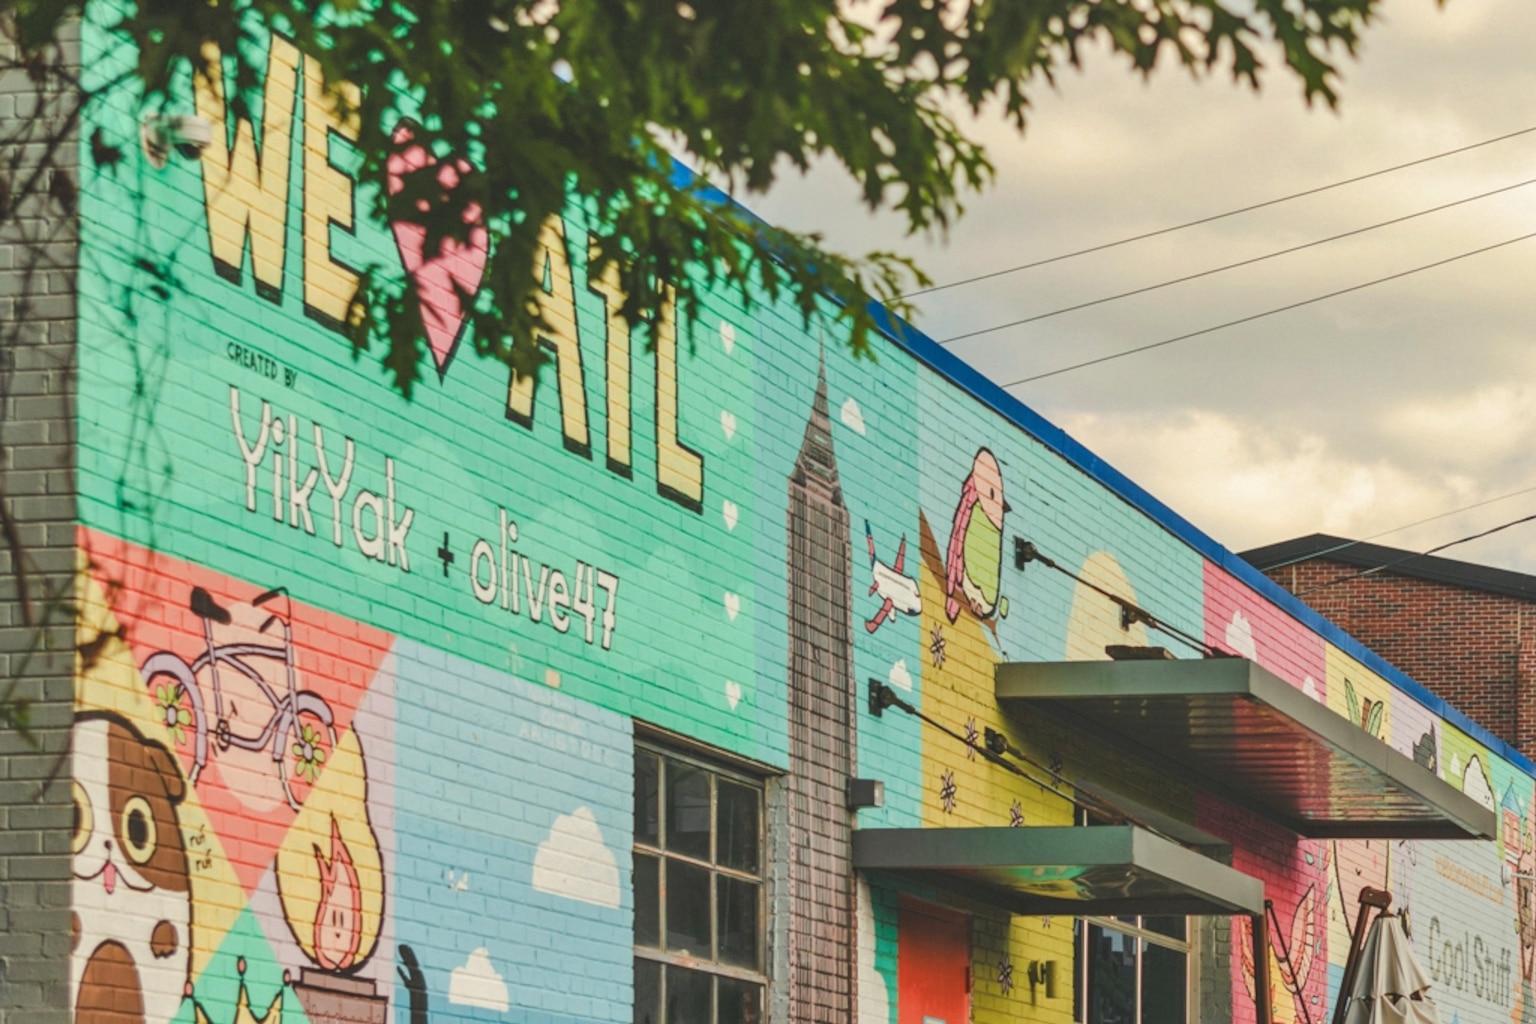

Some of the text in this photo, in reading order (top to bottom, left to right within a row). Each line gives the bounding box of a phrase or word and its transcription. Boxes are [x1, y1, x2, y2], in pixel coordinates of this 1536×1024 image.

[194, 32, 704, 516] WE ATL
[227, 341, 298, 389] CREATED BY
[228, 384, 415, 573] YikYak
[470, 507, 619, 650] olive47
[1429, 916, 1511, 1008] Cool Stuff
